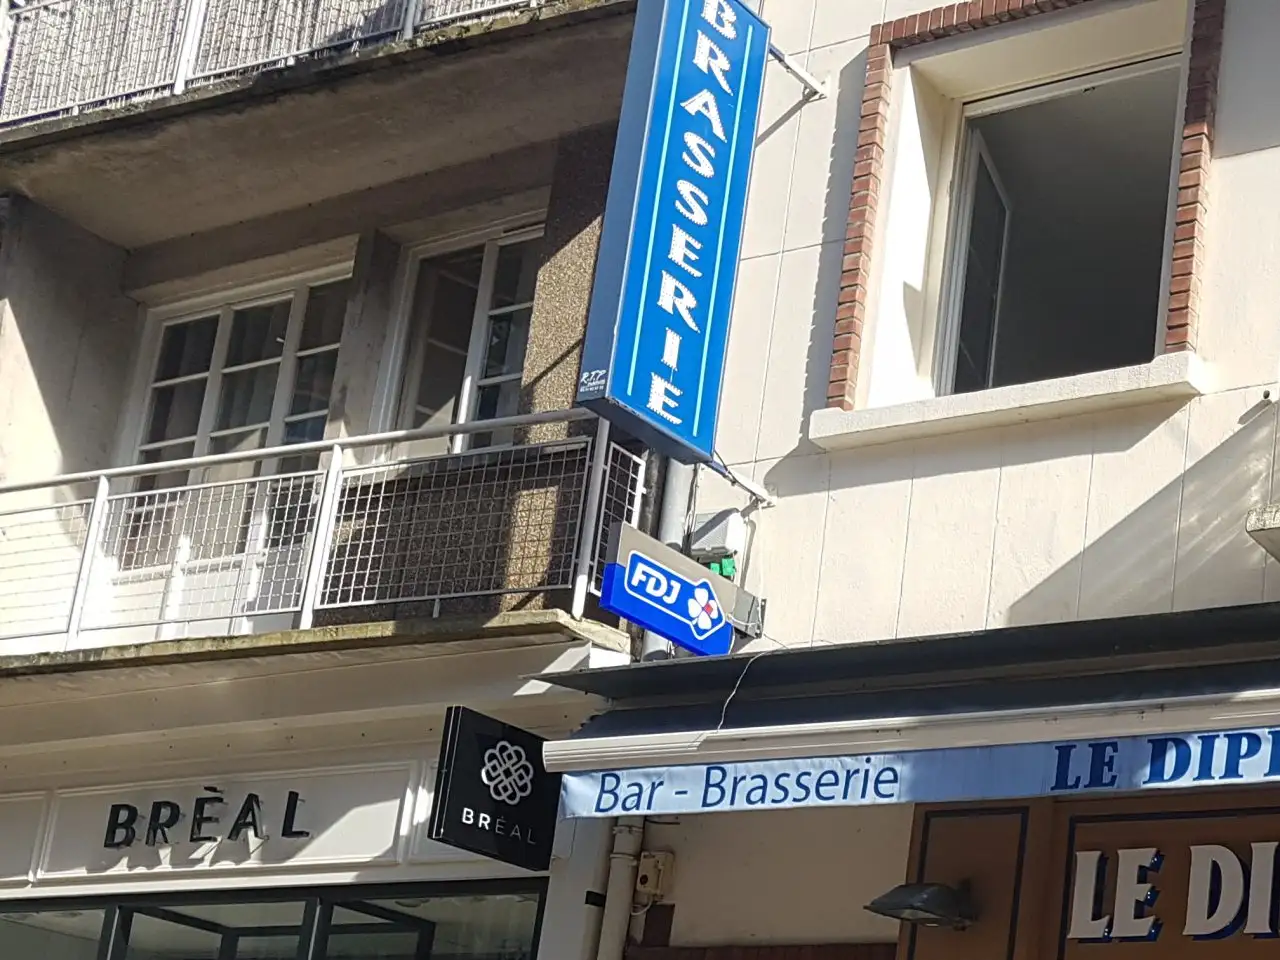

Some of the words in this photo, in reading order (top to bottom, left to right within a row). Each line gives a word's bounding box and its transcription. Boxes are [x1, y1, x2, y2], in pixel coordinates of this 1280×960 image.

[646, 0, 737, 425] BRASSERIE
[631, 562, 681, 604] FDJ
[594, 773, 664, 813] Bar
[701, 757, 899, 808] Brasserie
[1051, 741, 1118, 791] LE
[1067, 847, 1164, 943] LE
